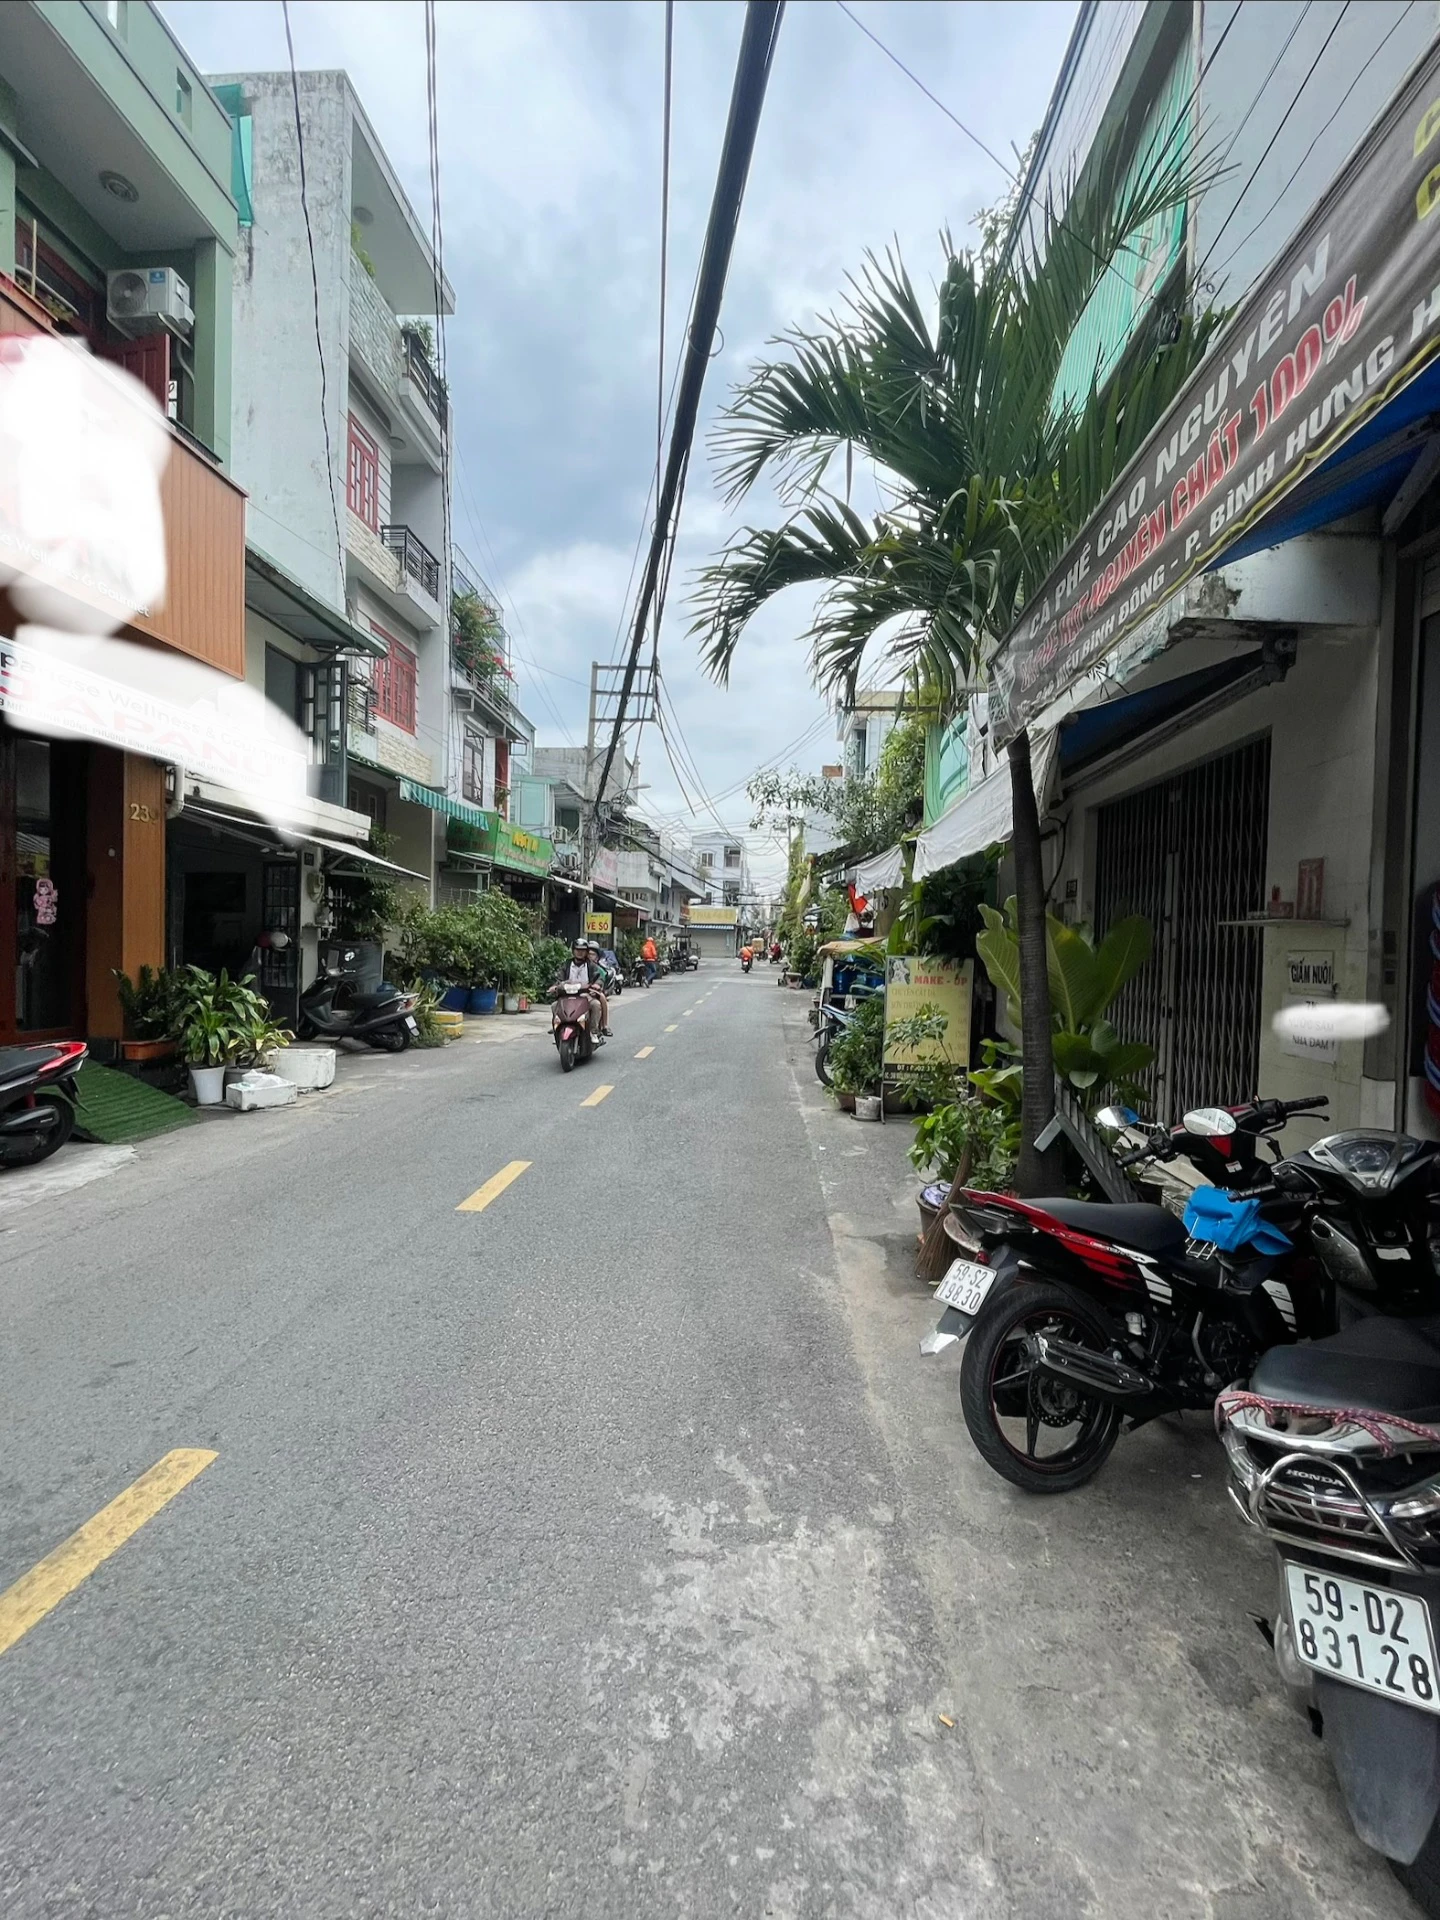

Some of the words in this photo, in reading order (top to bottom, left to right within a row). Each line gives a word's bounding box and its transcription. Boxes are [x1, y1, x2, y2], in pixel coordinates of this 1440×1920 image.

[1097, 476, 1146, 556] CAO
[1155, 232, 1330, 489] NGUYÊN
[1088, 500, 1166, 620] NGUYÊN
[1171, 408, 1241, 532] CHẤT
[1250, 274, 1368, 445] 100%
[1083, 613, 1115, 663] BÌNH
[1118, 564, 1165, 625] ĐÔNG
[1185, 529, 1202, 562] P.
[1209, 451, 1275, 537] BÌNH
[1285, 335, 1394, 464] HƯNG
[914, 975, 944, 985] MAKE
[939, 1280, 981, 1310] 198.30
[955, 1264, 988, 1289] 59-S2
[1286, 1468, 1347, 1487] HONDA
[1304, 1573, 1410, 1645] 59-D2
[1299, 1618, 1433, 1700] 831.28
